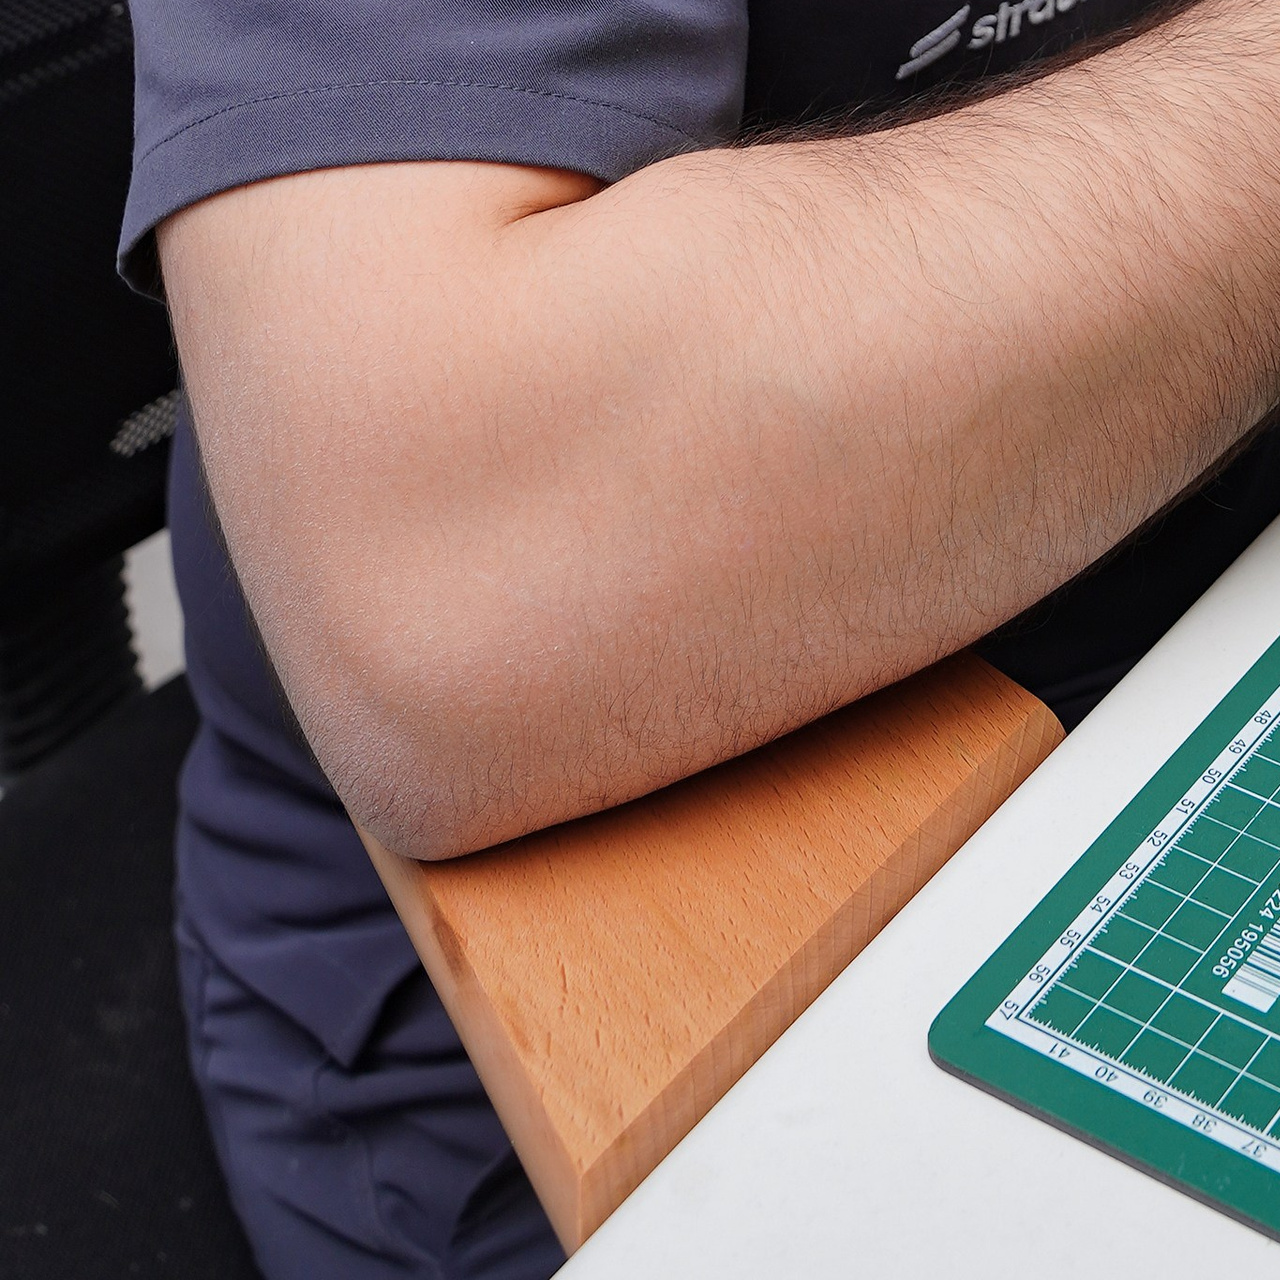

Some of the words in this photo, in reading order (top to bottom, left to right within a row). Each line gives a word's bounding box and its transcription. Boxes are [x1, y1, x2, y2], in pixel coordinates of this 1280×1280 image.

[1254, 709, 1272, 725] 48
[1228, 738, 1247, 754] 49
[1202, 768, 1222, 784] 50
[1176, 798, 1196, 815] 51
[1147, 829, 1168, 847] 52
[1119, 861, 1140, 880] 53
[1089, 895, 1111, 914] 54
[1060, 929, 1082, 949] 55
[1212, 922, 1264, 979] 195056
[1029, 963, 1051, 984] 56
[999, 999, 1019, 1021] 57
[1048, 1042, 1071, 1059] 41
[1094, 1065, 1119, 1083] 40
[1142, 1089, 1168, 1109] 39
[1191, 1113, 1218, 1134] 38
[1241, 1139, 1268, 1159] 37
